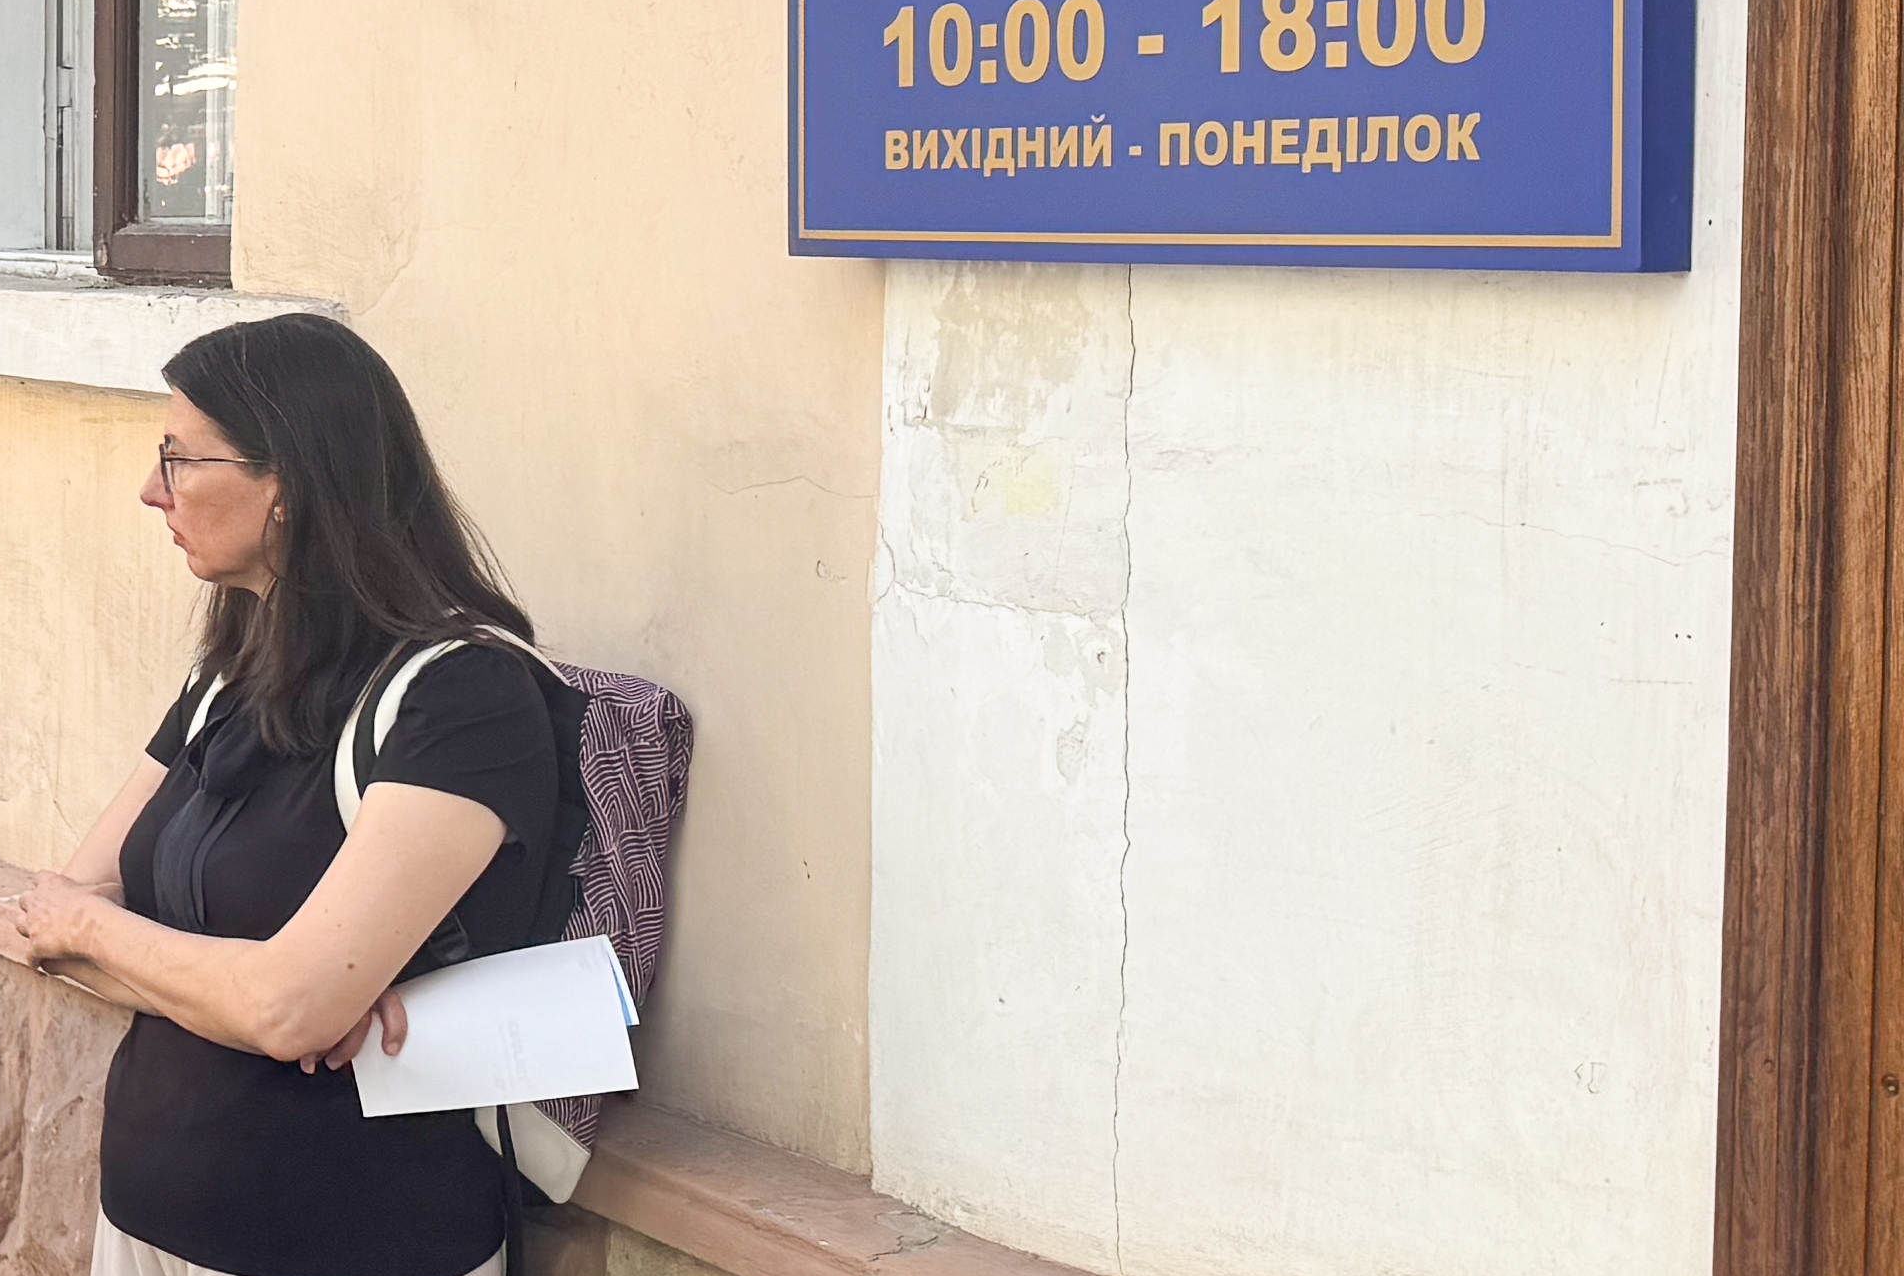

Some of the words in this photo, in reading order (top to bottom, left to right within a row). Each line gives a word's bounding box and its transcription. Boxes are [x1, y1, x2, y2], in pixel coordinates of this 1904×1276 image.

[1136, 33, 1167, 58] -
[883, 115, 1115, 180] ВИХІДНИЙ
[1127, 144, 1144, 159] -
[1158, 111, 1483, 176] ПОНЕДІЛОК
